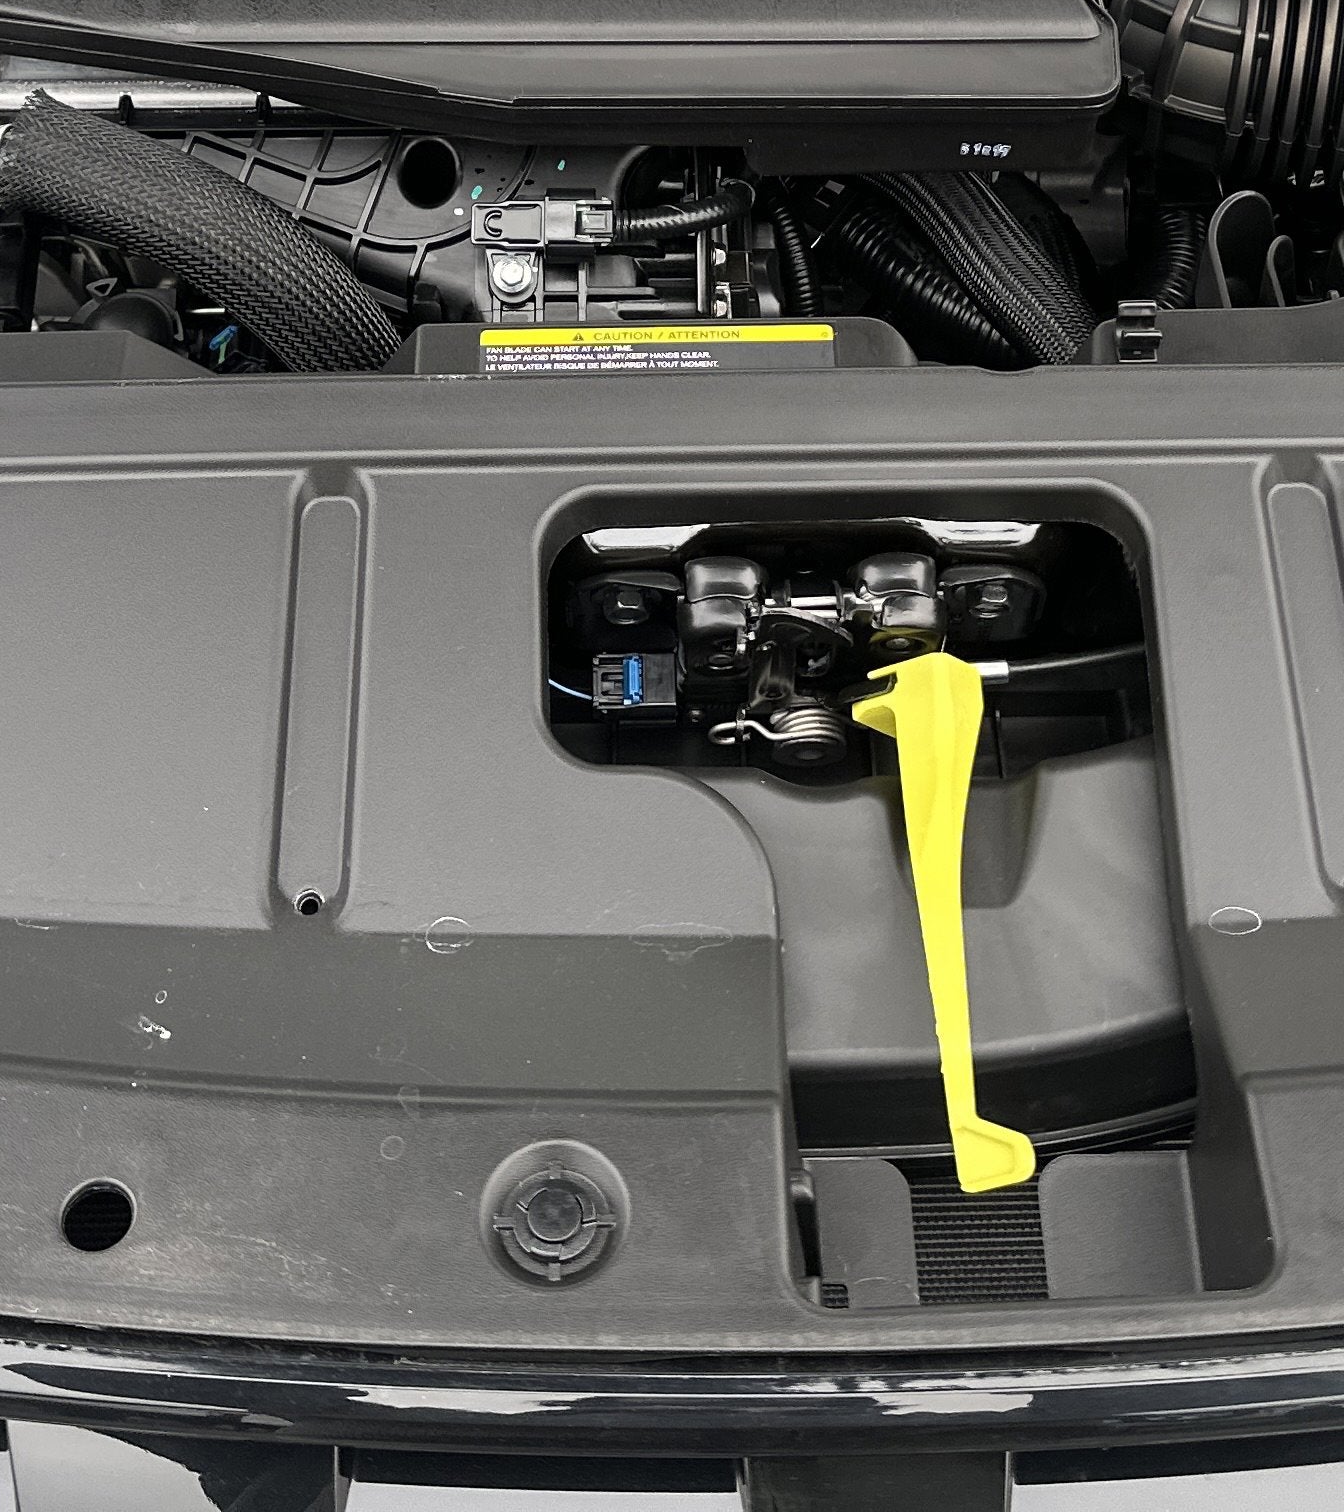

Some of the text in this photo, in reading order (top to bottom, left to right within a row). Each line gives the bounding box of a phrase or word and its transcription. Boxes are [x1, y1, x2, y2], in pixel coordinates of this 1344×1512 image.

[593, 331, 653, 342] CAUTION
[668, 330, 740, 340] ATTENTION
[504, 346, 532, 354] BLADE
[554, 345, 581, 353] START
[499, 354, 522, 362] HELP
[550, 353, 595, 361] PERSONAL
[680, 351, 711, 359] CLEAR.
[497, 363, 553, 371] VENTILATEUR
[601, 361, 647, 369] DÉMARRER
[680, 360, 719, 368] MOMENT.
